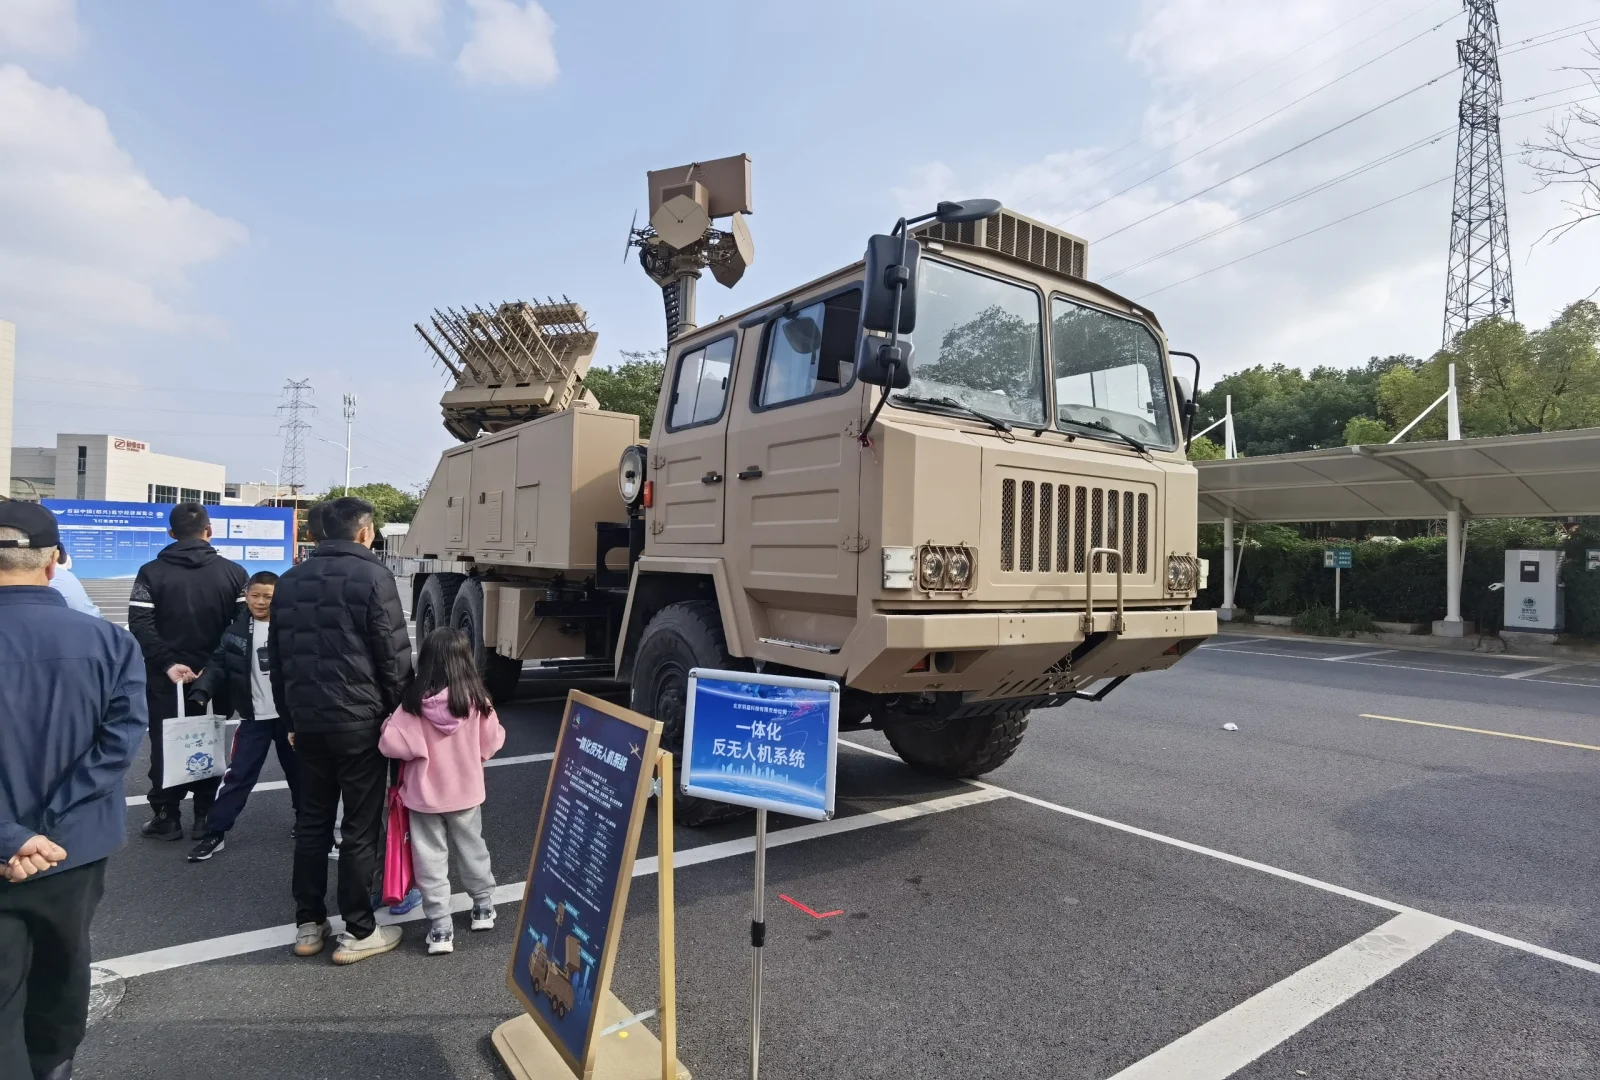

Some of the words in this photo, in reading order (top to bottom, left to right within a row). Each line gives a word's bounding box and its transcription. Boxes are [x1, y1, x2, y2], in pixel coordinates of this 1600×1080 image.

[735, 720, 782, 742] 一体化
[575, 736, 629, 772] 一体化反无人机系统
[712, 738, 806, 769] 反无人机系统
